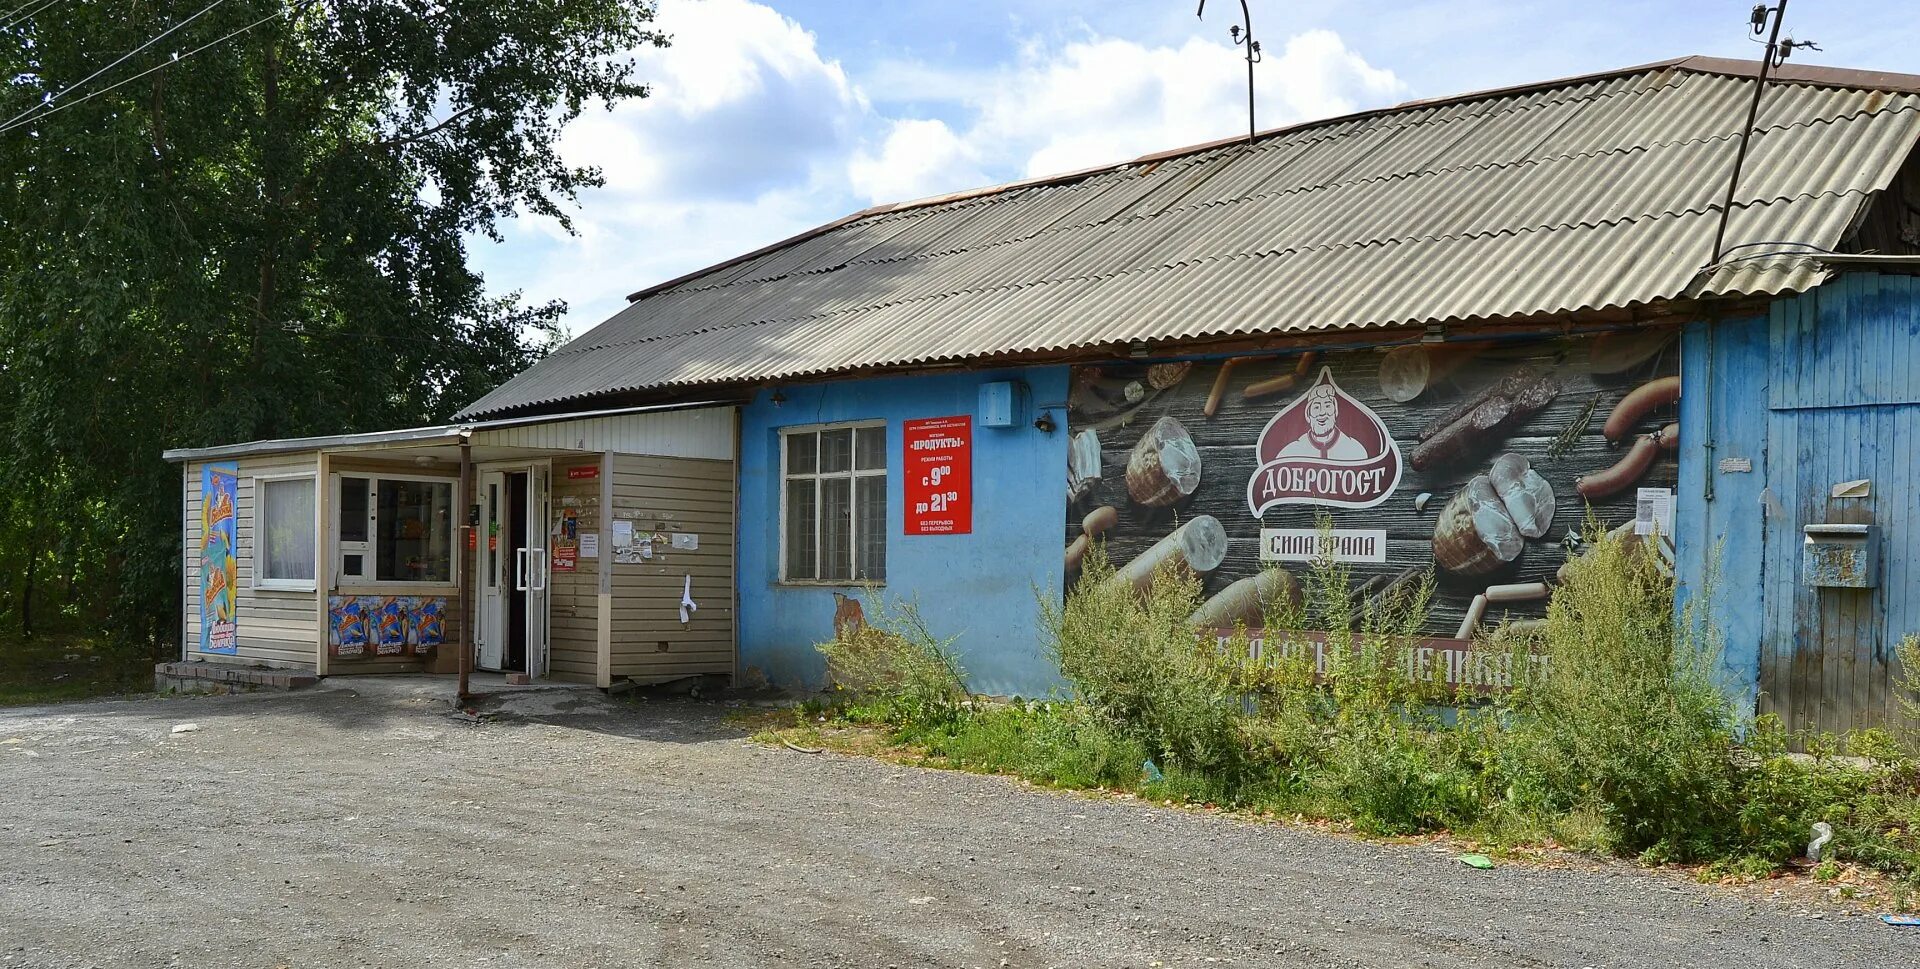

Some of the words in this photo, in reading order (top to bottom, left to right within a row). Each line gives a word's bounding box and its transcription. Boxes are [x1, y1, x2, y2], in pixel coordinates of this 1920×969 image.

[910, 437, 965, 451] «ПРОДУКТЫ»
[1262, 466, 1386, 498] ДОБРОГОСТ
[1270, 535, 1314, 555] СИЛА
